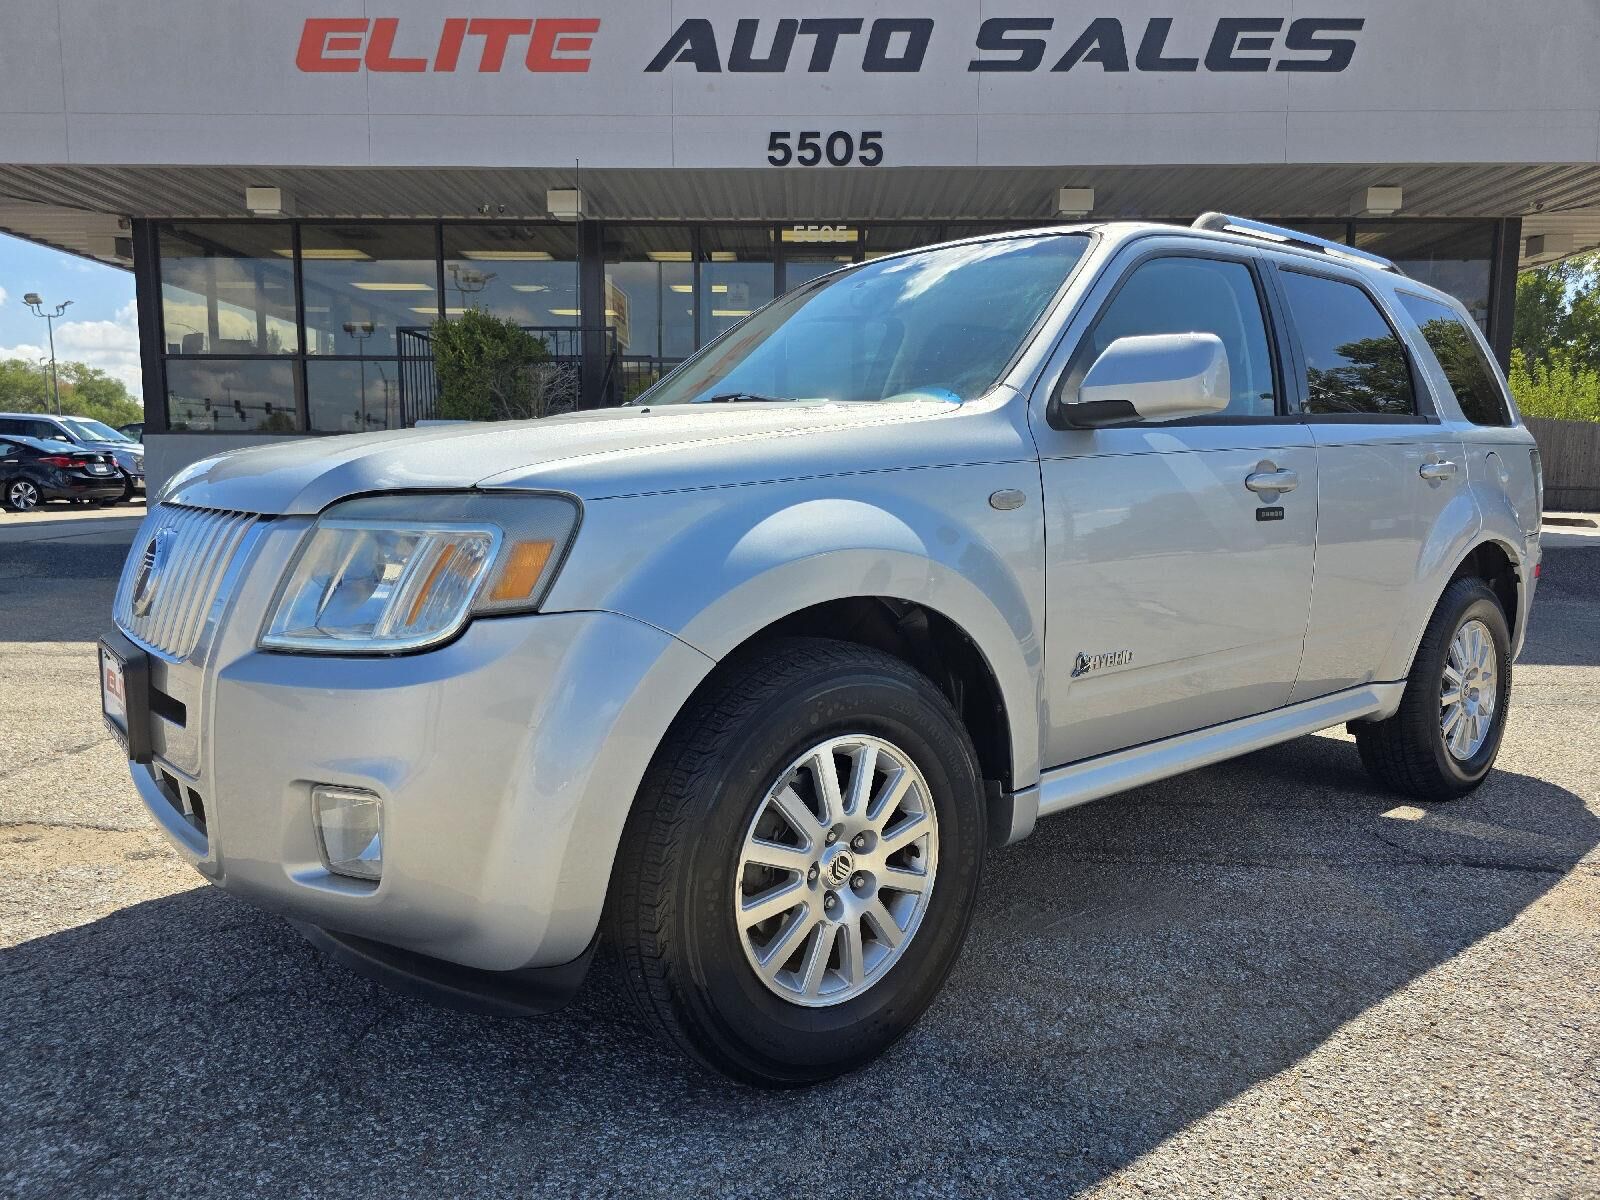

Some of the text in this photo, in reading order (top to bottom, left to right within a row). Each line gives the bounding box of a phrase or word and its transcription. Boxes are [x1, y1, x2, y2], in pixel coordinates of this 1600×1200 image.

[296, 17, 1366, 73] ELITE AUTO SALES
[767, 130, 884, 167] 5505
[793, 225, 848, 243] 5505
[1089, 650, 1134, 670] HYBRID
